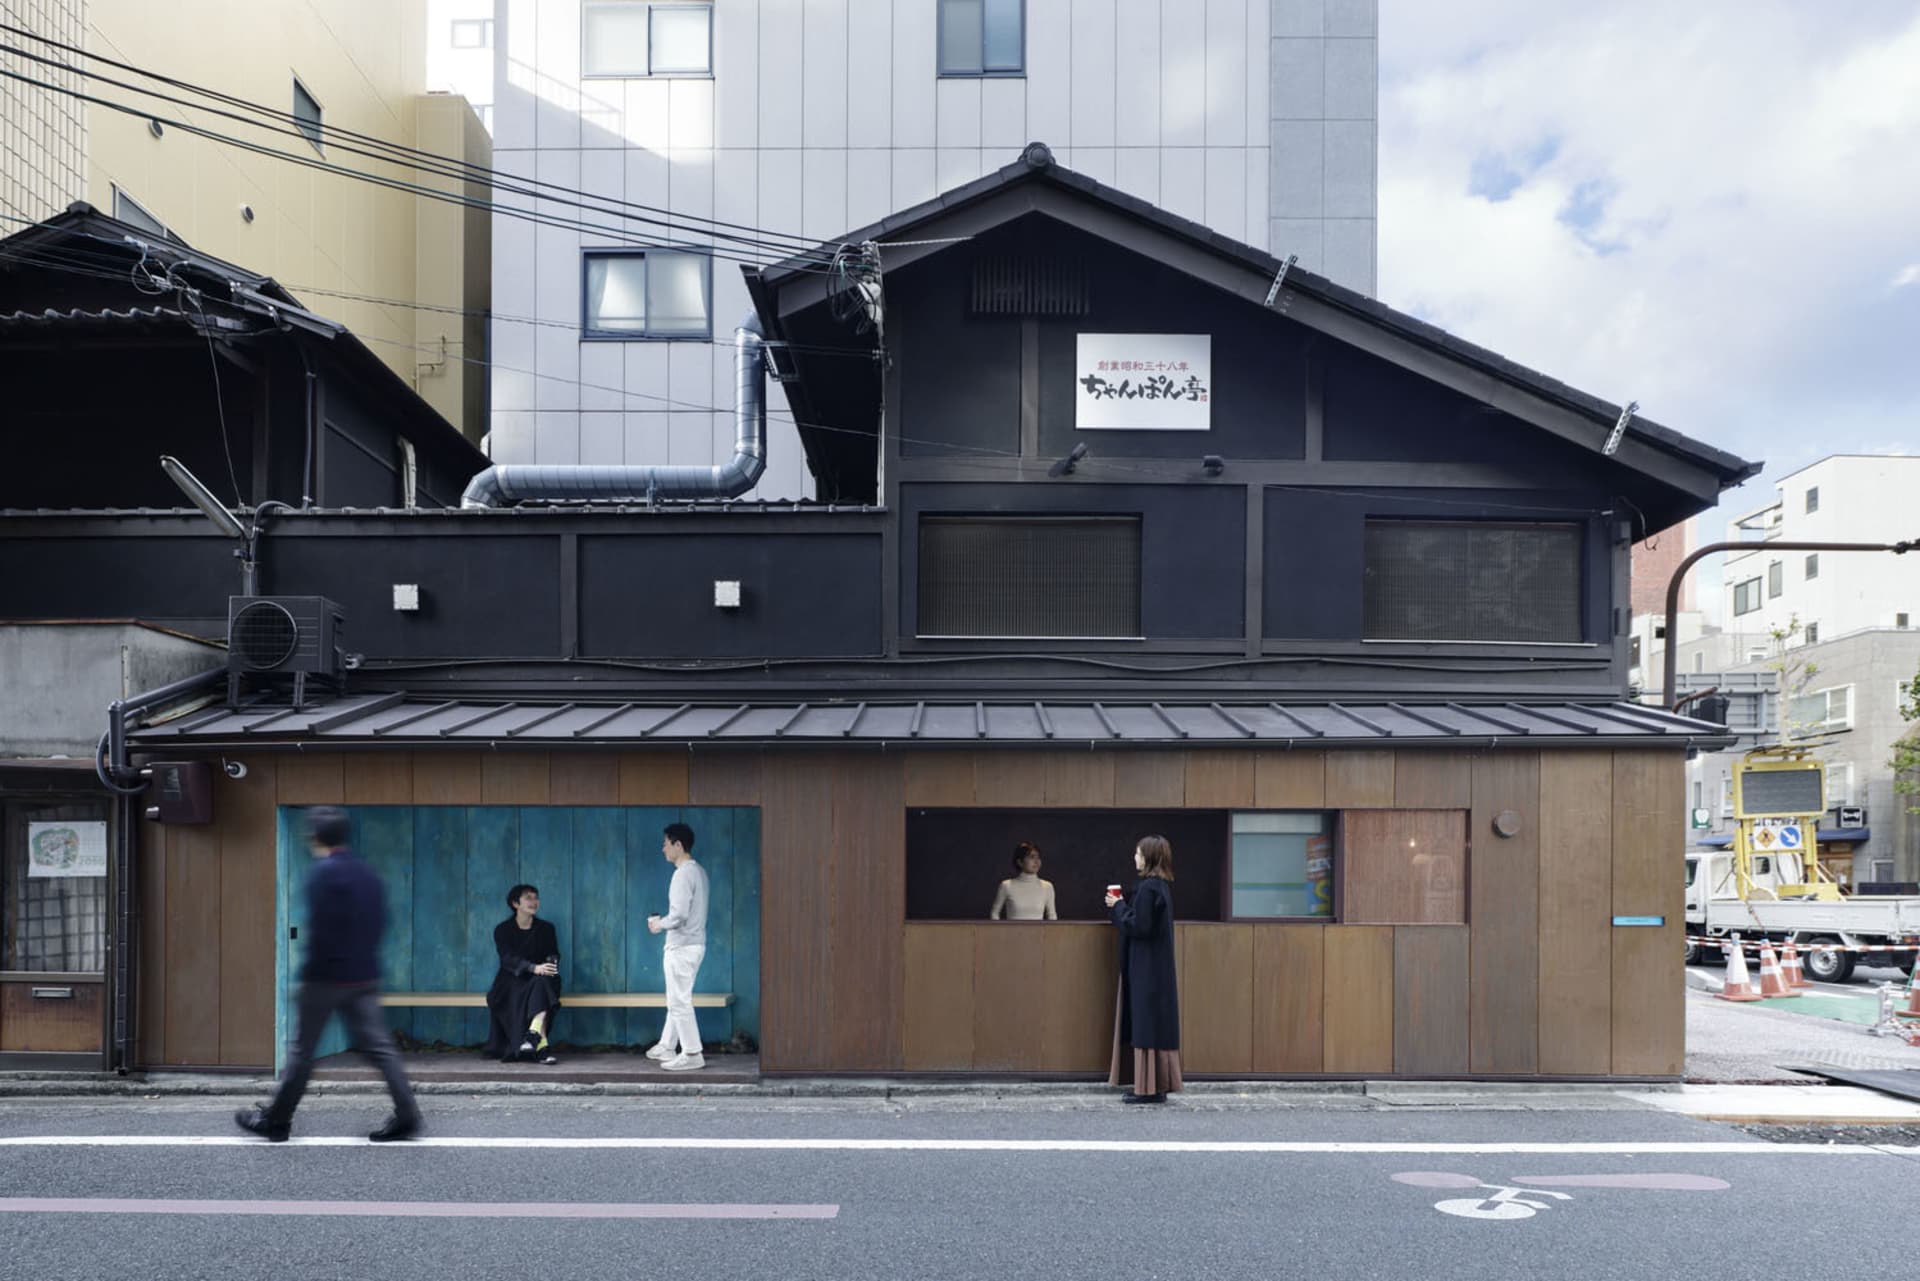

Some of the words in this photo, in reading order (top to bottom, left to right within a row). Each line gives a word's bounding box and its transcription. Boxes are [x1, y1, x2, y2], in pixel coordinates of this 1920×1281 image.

[1097, 360, 1189, 372] 創業昭和三十八年
[1079, 374, 1207, 402] ちゃんぽん亭
